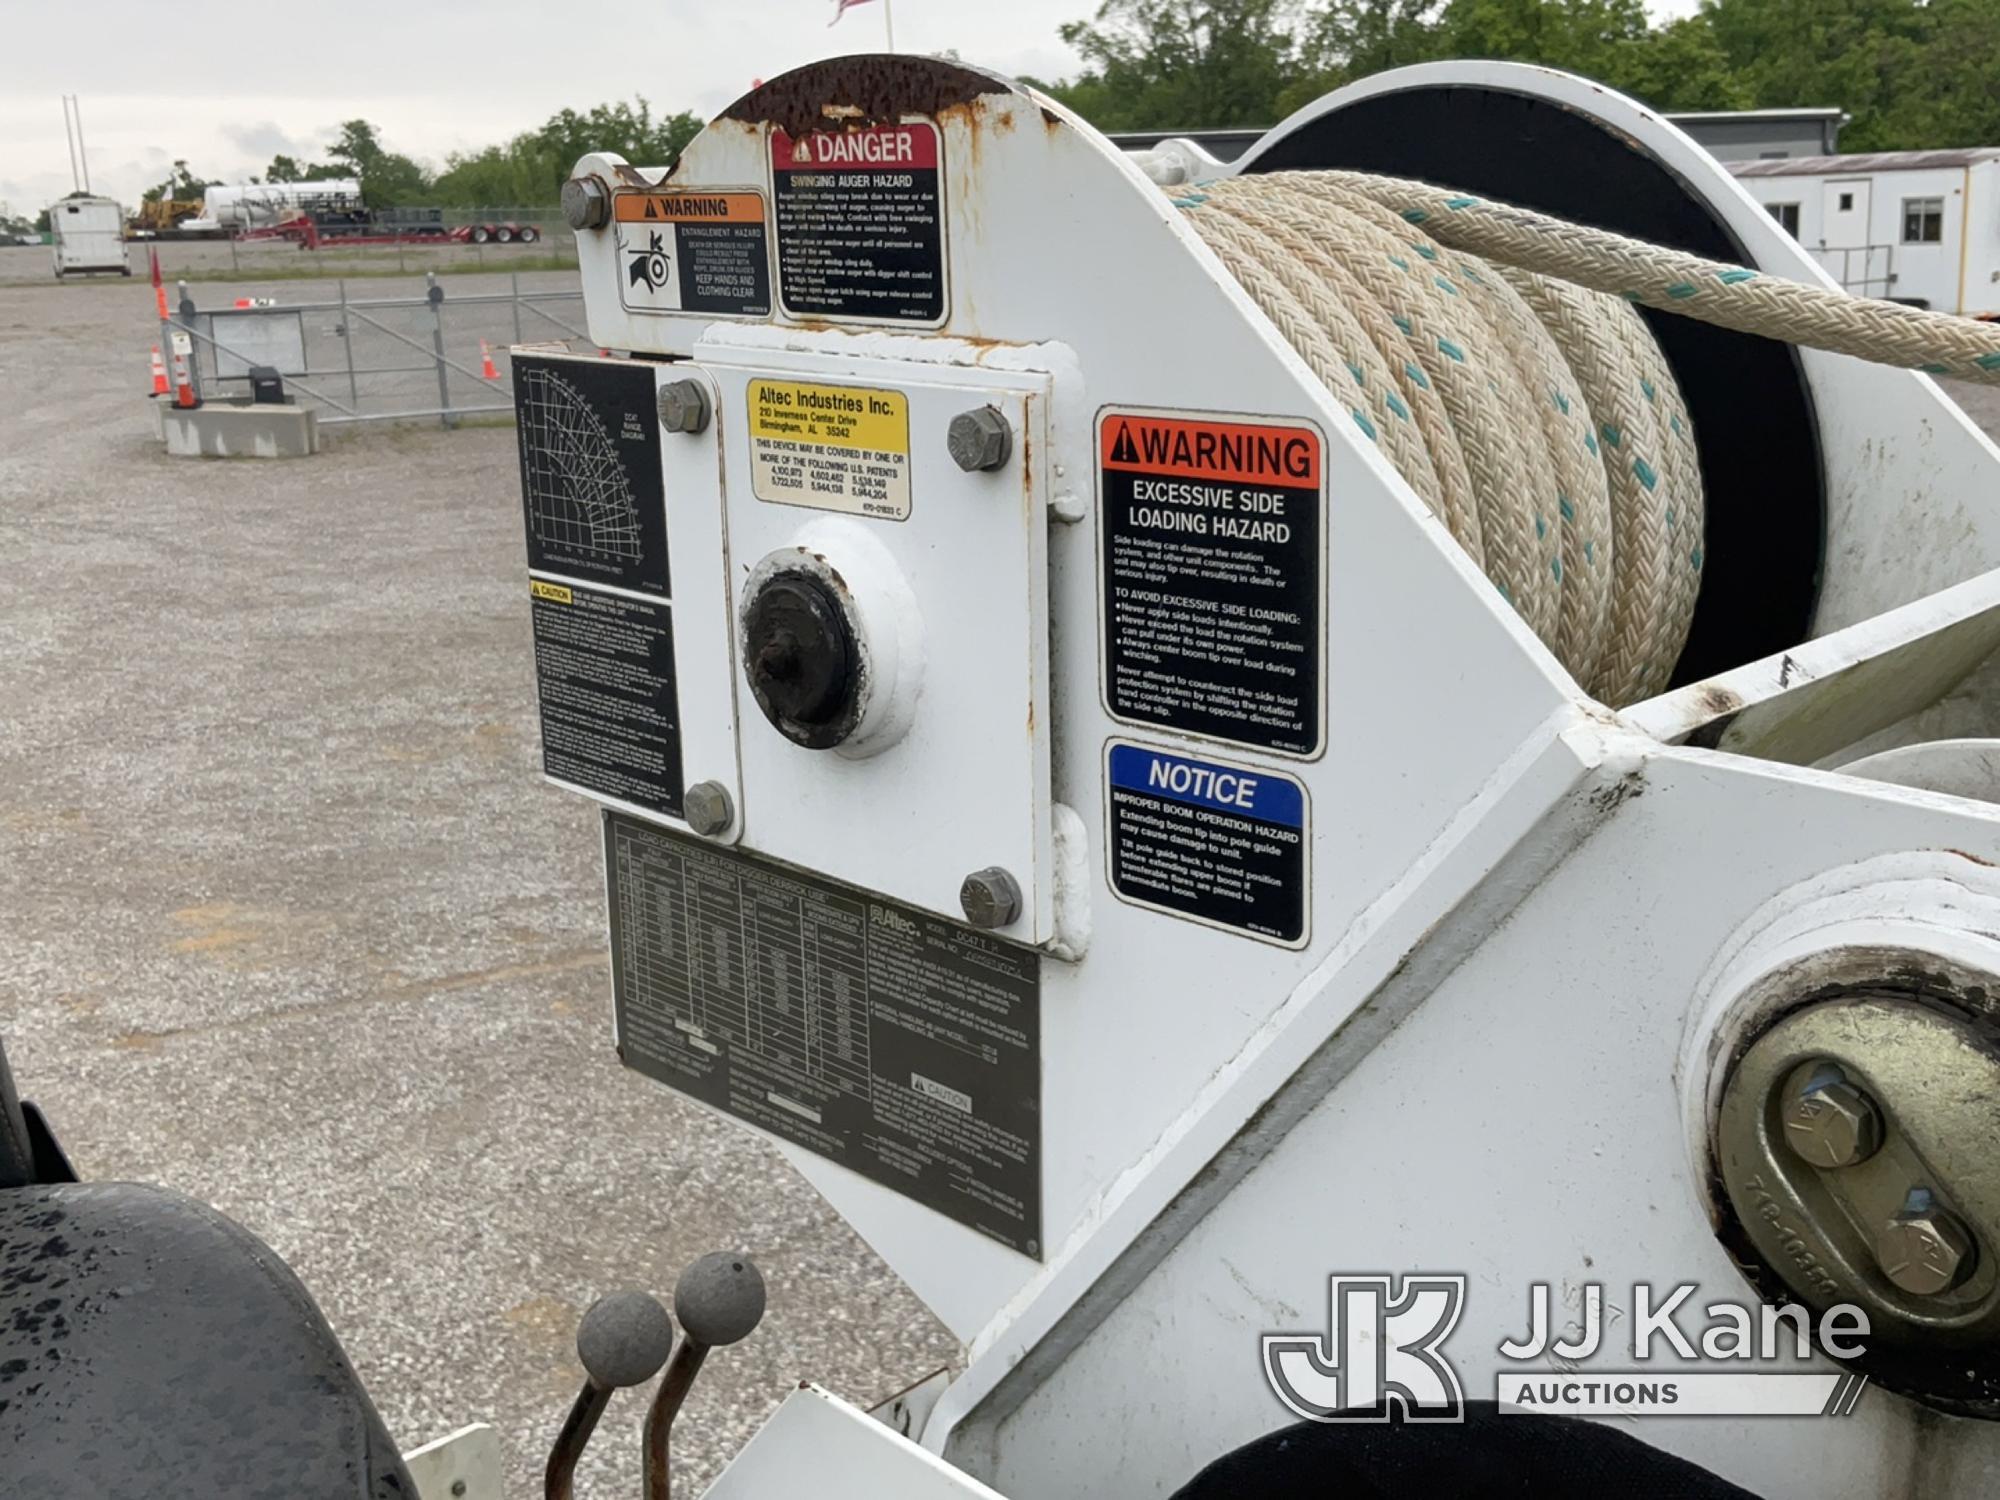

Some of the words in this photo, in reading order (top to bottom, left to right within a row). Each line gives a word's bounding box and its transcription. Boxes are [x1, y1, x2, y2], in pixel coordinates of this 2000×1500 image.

[817, 132, 912, 162] DANGER
[790, 175, 835, 187] SWINGING
[838, 175, 870, 187] AUGER
[873, 175, 912, 187] HAZARD
[660, 198, 728, 216] WARNING
[681, 227, 730, 237] ENTANGLEMENT
[734, 228, 761, 237] HAZARD
[696, 274, 712, 283] KEEP
[714, 275, 738, 285] HANDS
[740, 276, 754, 285] AND
[697, 285, 731, 296] CLOTHING
[732, 287, 754, 297] CLEAR
[759, 387, 791, 406] Altec
[797, 390, 863, 412] Industries
[869, 396, 893, 415] Inc.
[1141, 427, 1310, 478] WARNING
[1134, 480, 1233, 509] EXCESSIVE
[1240, 491, 1284, 514] SIDE
[1130, 506, 1206, 533] LOADING
[1213, 516, 1290, 543] HAZARD
[1114, 534, 1131, 544] Side
[1133, 537, 1162, 550] loading
[1180, 544, 1213, 556] damage
[1215, 548, 1229, 557] the
[1231, 551, 1263, 562] rotation
[1114, 568, 1143, 578] serious
[1130, 560, 1146, 569] may
[1148, 562, 1165, 571] also
[1167, 564, 1178, 573] tip
[1201, 570, 1237, 582] resulting
[1239, 574, 1247, 582] in
[1249, 575, 1274, 586] death
[1146, 551, 1161, 559] and
[1163, 553, 1184, 562] other
[1186, 557, 1201, 565] unit
[1264, 565, 1280, 575] The
[541, 586, 569, 600] CAUTION
[1115, 587, 1128, 597] TO
[1130, 590, 1160, 602] AVOID
[1162, 594, 1218, 612] EXCESSIVE
[1222, 603, 1246, 616] SIDE
[1121, 602, 1145, 613] Never
[1147, 608, 1170, 618] apply
[1172, 611, 1190, 621] side
[1192, 613, 1216, 625] loads
[1121, 614, 1145, 625] Never
[1147, 620, 1178, 631] exceed
[1179, 624, 1194, 634] the
[1196, 626, 1214, 637] load
[1217, 630, 1231, 640] the
[1233, 634, 1268, 646] rotation
[1270, 640, 1303, 652] system
[1122, 627, 1137, 635] can
[1139, 630, 1154, 638] pull
[1156, 633, 1181, 642] under
[1183, 636, 1194, 645] its
[1195, 640, 1214, 649] own
[1122, 637, 1151, 649] Always
[1153, 644, 1180, 654] center
[1182, 647, 1206, 659] boom
[1208, 652, 1220, 662] tip
[1222, 656, 1241, 665] over
[1244, 658, 1263, 669] load
[1265, 662, 1295, 676] during
[1116, 664, 1141, 676] Never
[1143, 671, 1175, 683] attempt
[1177, 676, 1186, 685] to
[1188, 680, 1235, 695] counteract
[1237, 688, 1253, 697] the
[1255, 691, 1275, 701] side
[1277, 694, 1298, 706] load
[1117, 677, 1159, 690] protection
[1161, 686, 1192, 697] system
[1193, 690, 1204, 701] by
[1206, 694, 1239, 708] shifting
[1242, 700, 1257, 710] the
[1259, 705, 1295, 717] rotation
[1149, 759, 1257, 808] NOTICE
[1114, 792, 1160, 810] IMPROPER
[1163, 803, 1193, 818] BOOM
[1196, 811, 1252, 832] OPERATION
[1255, 825, 1299, 843] HAZARD
[1120, 808, 1164, 829] Extending
[1166, 820, 1193, 834] boom
[1194, 827, 1207, 839] tip
[1209, 830, 1228, 842] into
[1230, 837, 1251, 848] pole
[1253, 843, 1281, 856] guide
[1120, 822, 1139, 834] may
[1141, 828, 1168, 840] cause
[1170, 834, 1206, 850] damage
[1208, 843, 1218, 853] to
[1120, 849, 1146, 862] before
[1148, 858, 1188, 875] extending
[1190, 869, 1214, 880] upper
[1217, 874, 1241, 888] boom
[1244, 882, 1250, 890] if
[1122, 838, 1133, 848] Tilt
[1136, 844, 1153, 853] pole
[1156, 849, 1178, 859] guide
[1180, 854, 1201, 866] back
[1204, 860, 1213, 869] to
[1216, 864, 1244, 877] stored
[1246, 872, 1282, 886] position
[1121, 871, 1170, 890] intermediate
[1121, 861, 1168, 879] transferable
[1197, 882, 1210, 890] are
[1213, 886, 1242, 899] pinned
[1244, 893, 1254, 902] to
[926, 1082, 969, 1110] CAUTION
